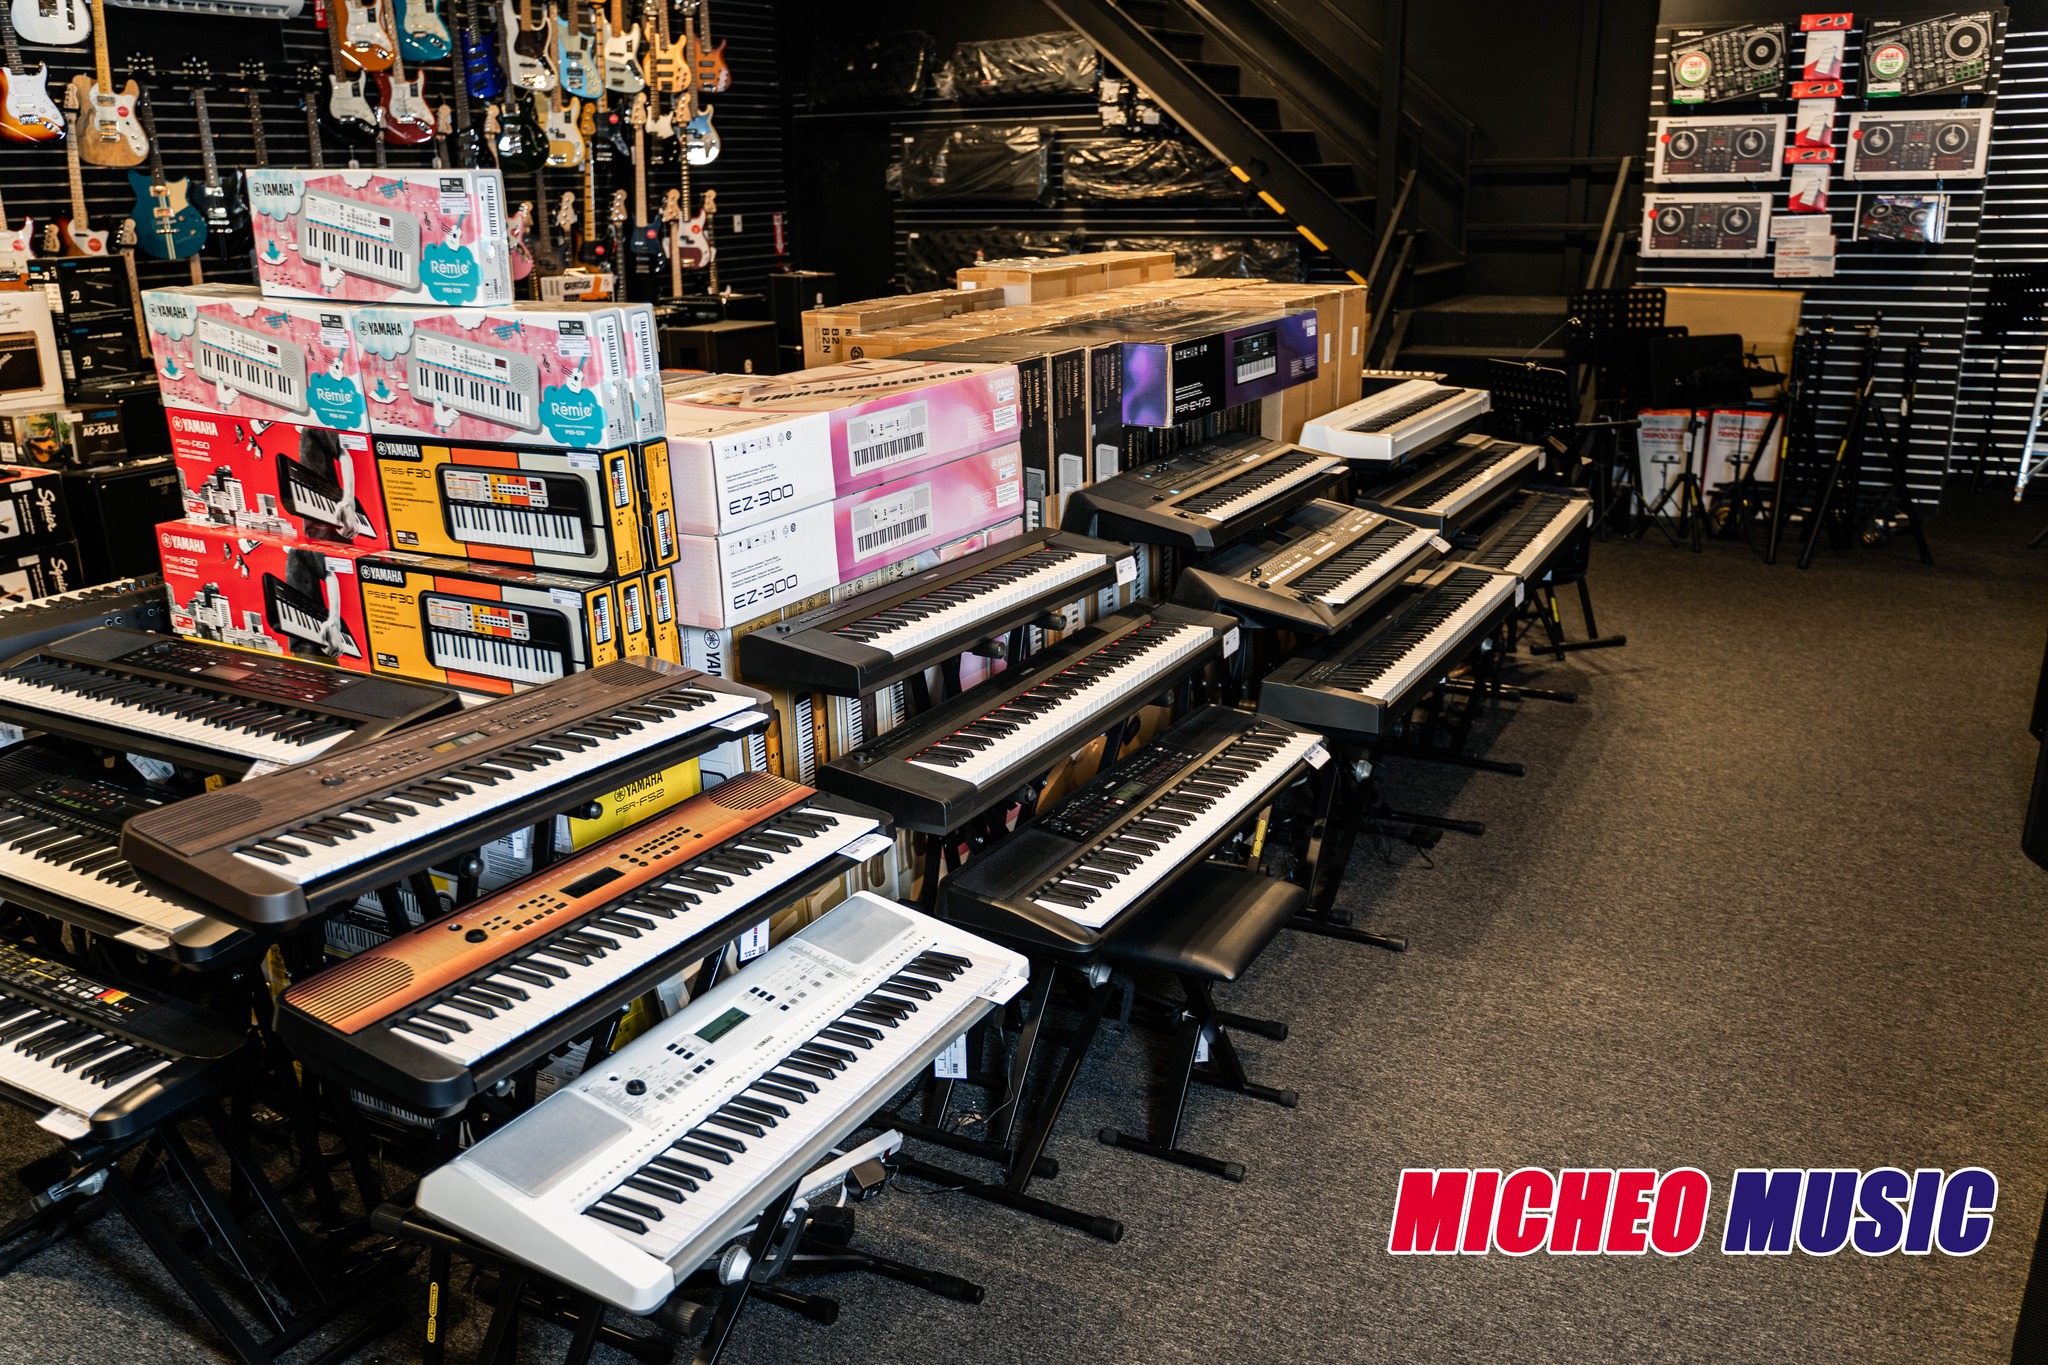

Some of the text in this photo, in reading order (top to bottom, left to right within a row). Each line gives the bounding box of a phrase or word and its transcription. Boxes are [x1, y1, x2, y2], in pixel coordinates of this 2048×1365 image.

[262, 184, 295, 196] YAMAHA
[157, 306, 188, 320] YAMAHA
[368, 322, 403, 336] YAMAHA
[832, 328, 840, 344] B2
[822, 328, 830, 354] B2N
[994, 376, 1016, 390] YAMAHA
[1175, 396, 1212, 414] PSR-E473
[83, 424, 120, 437] AC-22LX
[182, 418, 218, 436] YAMAHA
[386, 442, 420, 458] YAMAHA
[998, 452, 1018, 466] YAMAHA
[384, 466, 432, 479] PSS-F30
[728, 484, 794, 516] EZ-300
[36, 488, 57, 532] Squier
[171, 535, 206, 554] YAMAHA
[48, 557, 68, 593] Squie
[370, 566, 404, 584] YAMAHA
[368, 590, 414, 604] PSS-F30
[734, 574, 798, 610] EZ-300
[626, 772, 664, 797] YAMAHA
[616, 788, 665, 816] PSR-F52
